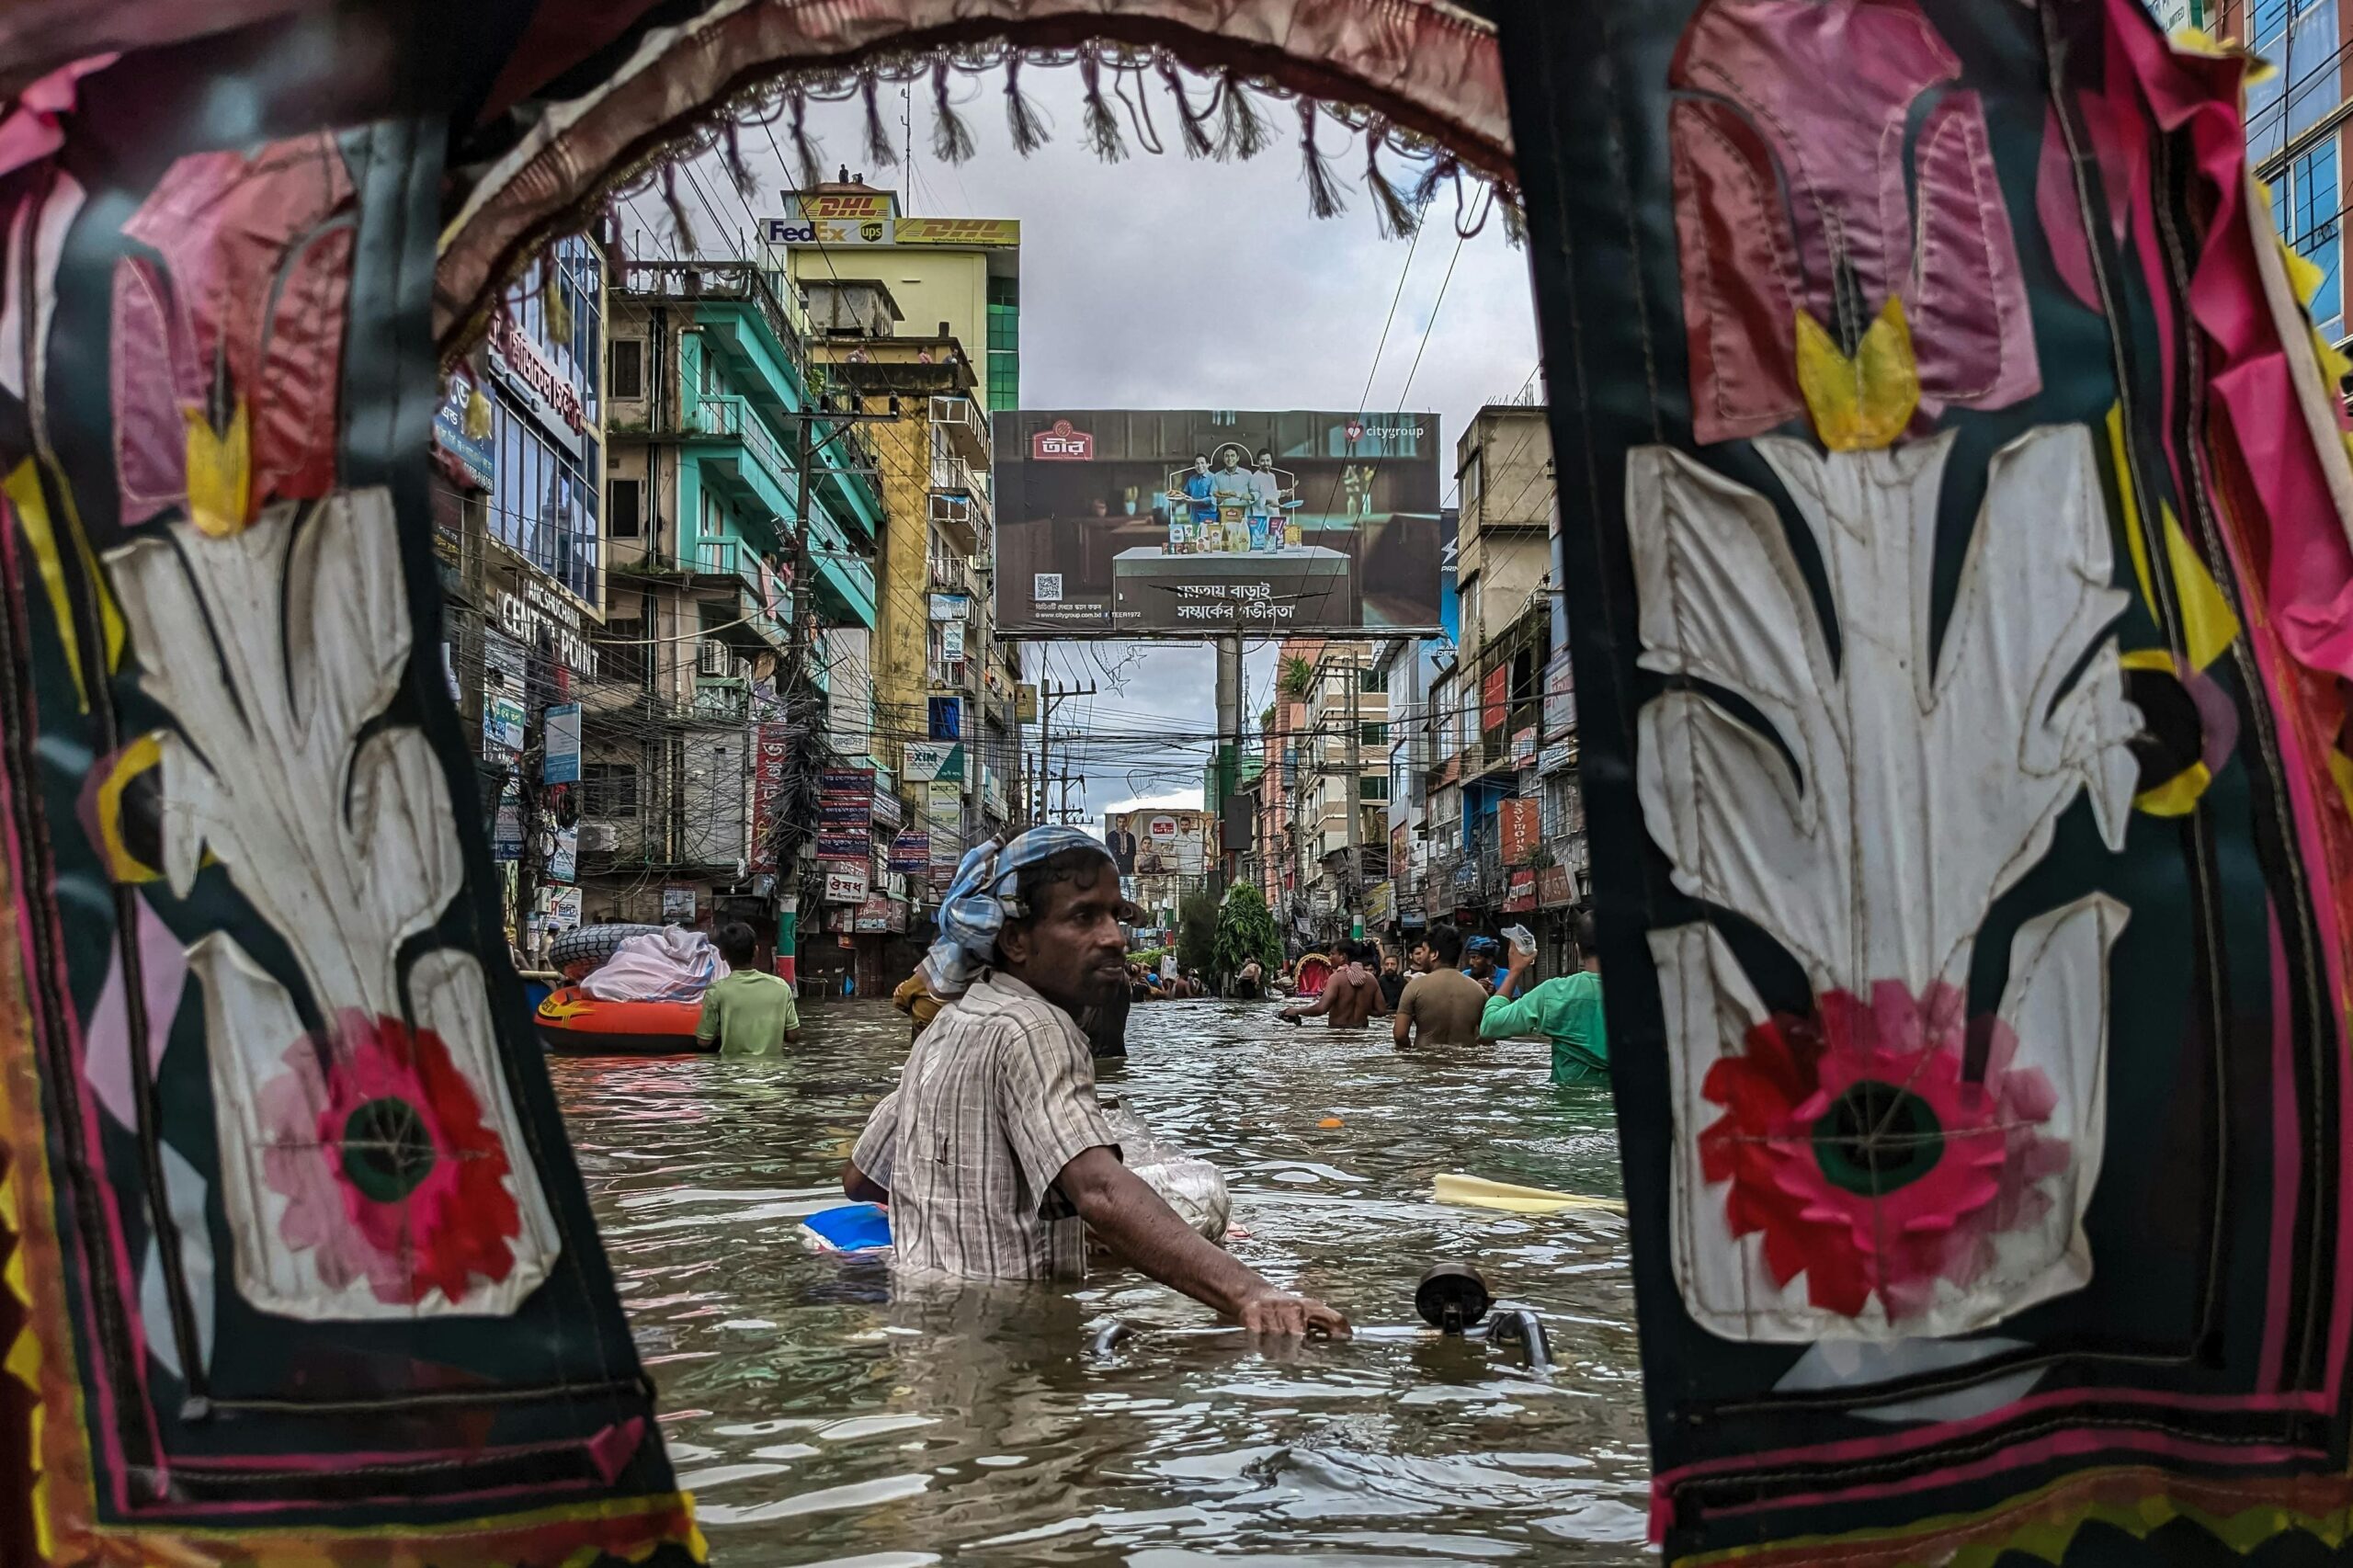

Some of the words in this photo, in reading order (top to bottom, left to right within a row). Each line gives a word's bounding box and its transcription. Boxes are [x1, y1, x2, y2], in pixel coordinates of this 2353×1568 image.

[819, 198, 877, 216] DHL
[769, 222, 847, 242] FedEx
[861, 227, 881, 241] ups
[922, 221, 1005, 238] DHL
[1366, 426, 1424, 438] citygroup
[1041, 437, 1086, 456] তীর
[1230, 582, 1272, 601] বাড়াই
[561, 629, 599, 684] POINT
[906, 752, 938, 762] EXIM
[828, 876, 864, 893] ঔষধ
